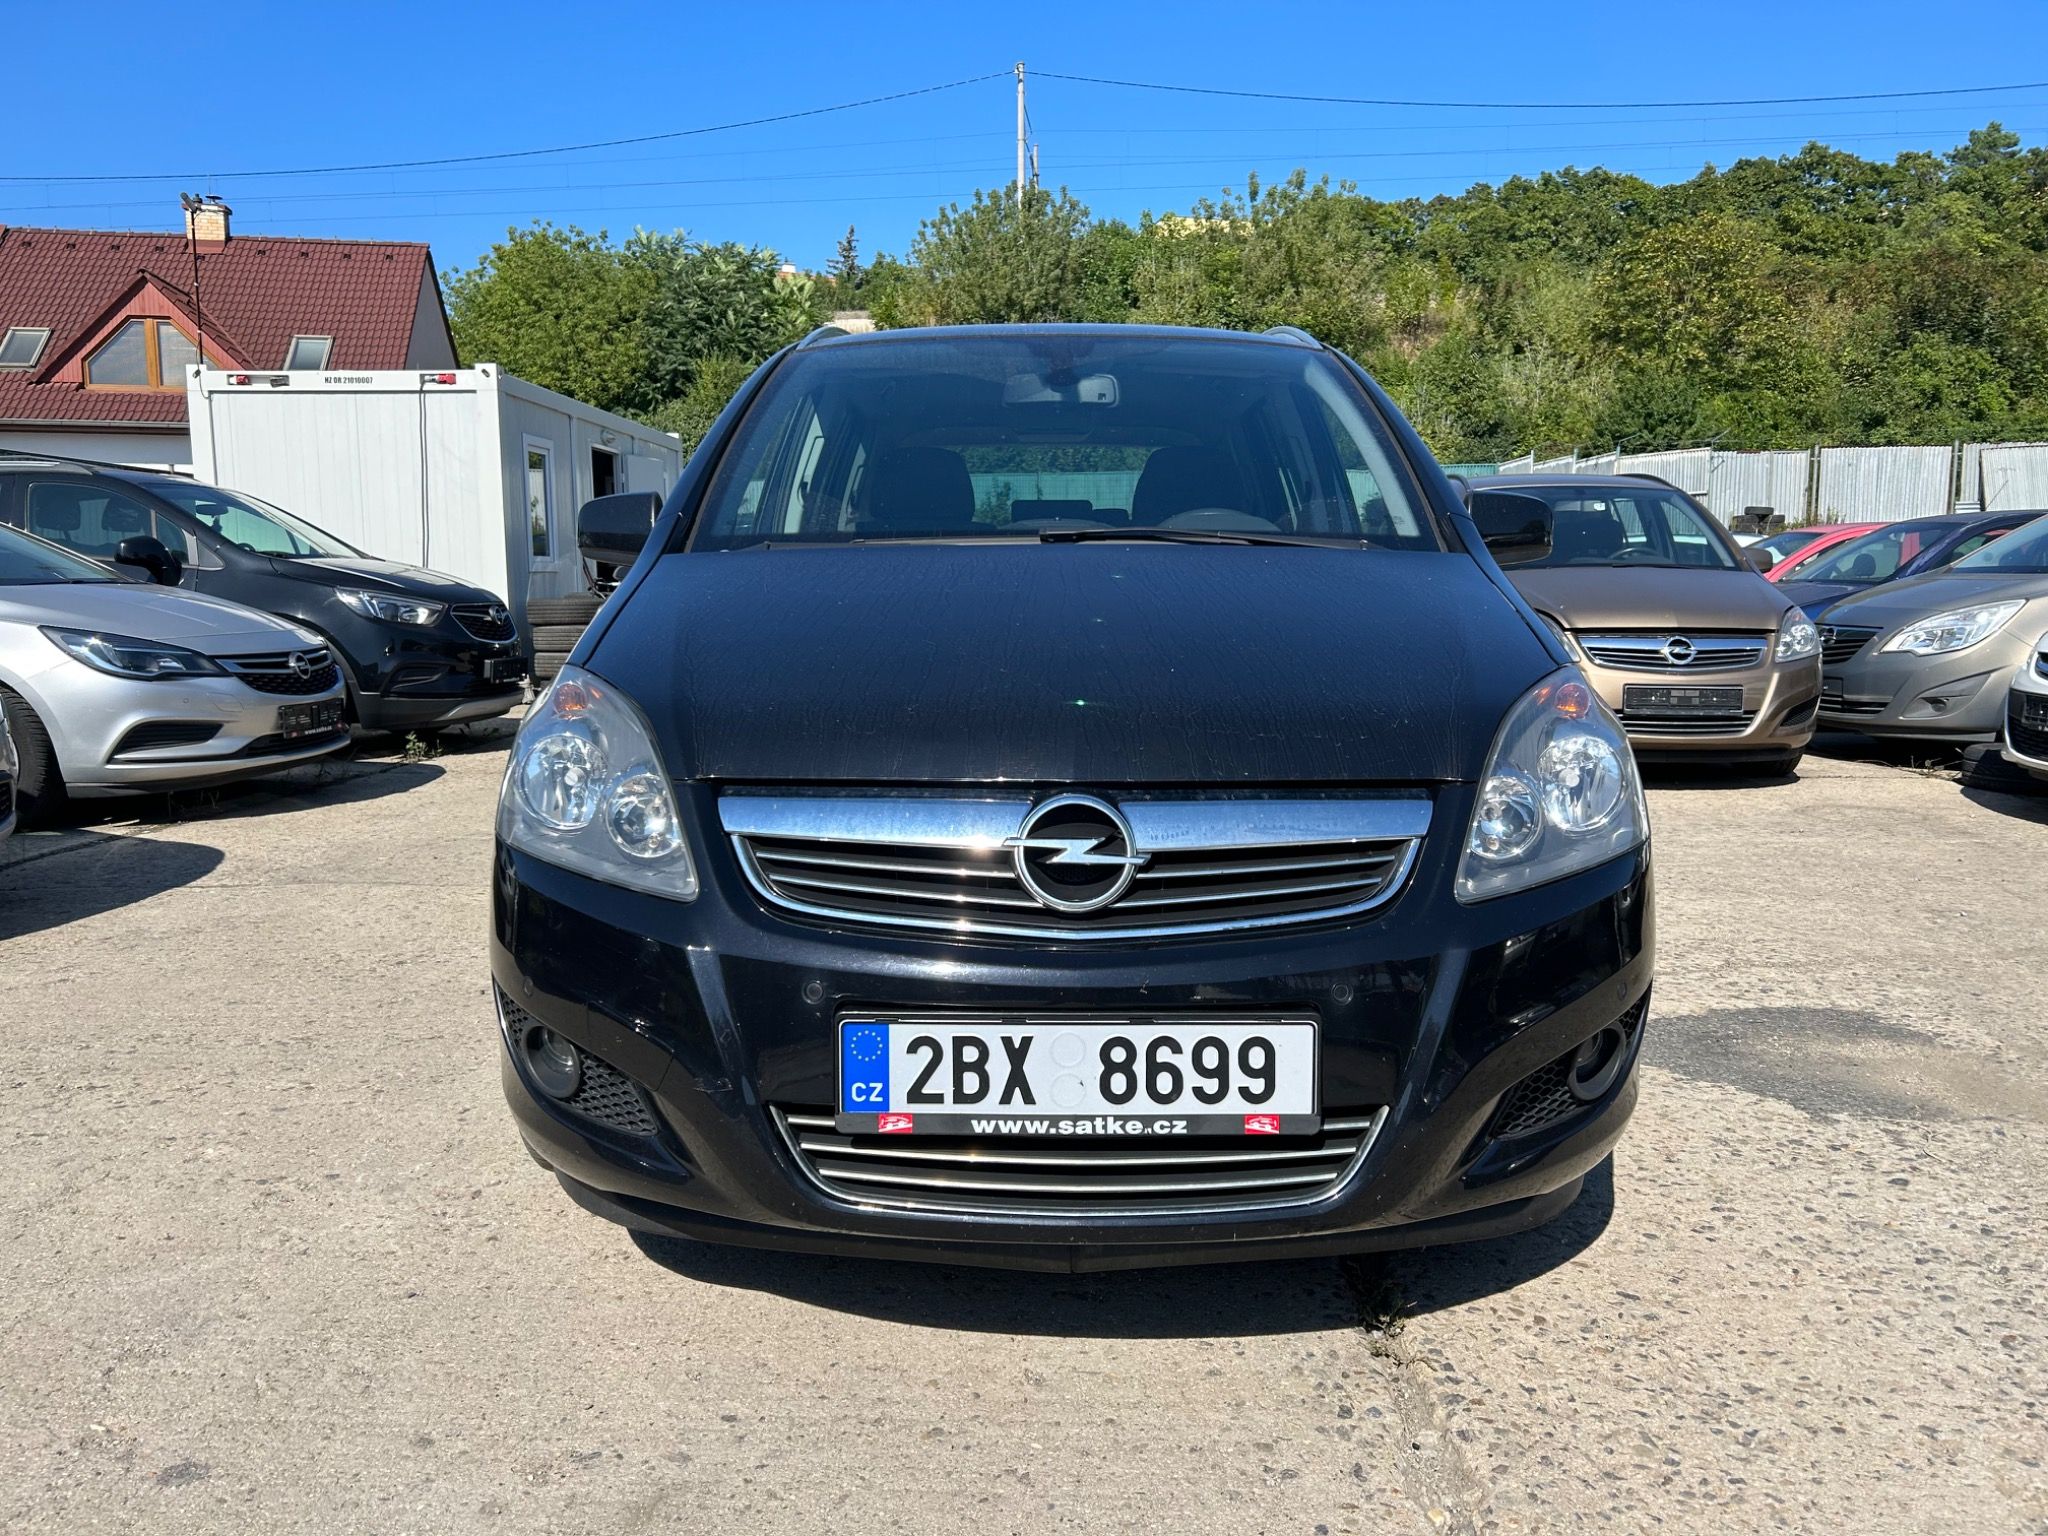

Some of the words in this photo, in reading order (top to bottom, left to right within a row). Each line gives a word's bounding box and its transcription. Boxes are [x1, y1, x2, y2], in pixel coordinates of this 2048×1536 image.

[906, 1035, 1037, 1105] 2BX
[1099, 1035, 1276, 1105] 8699
[851, 1082, 884, 1103] CZ
[970, 1116, 1188, 1135] www.satke.cz
